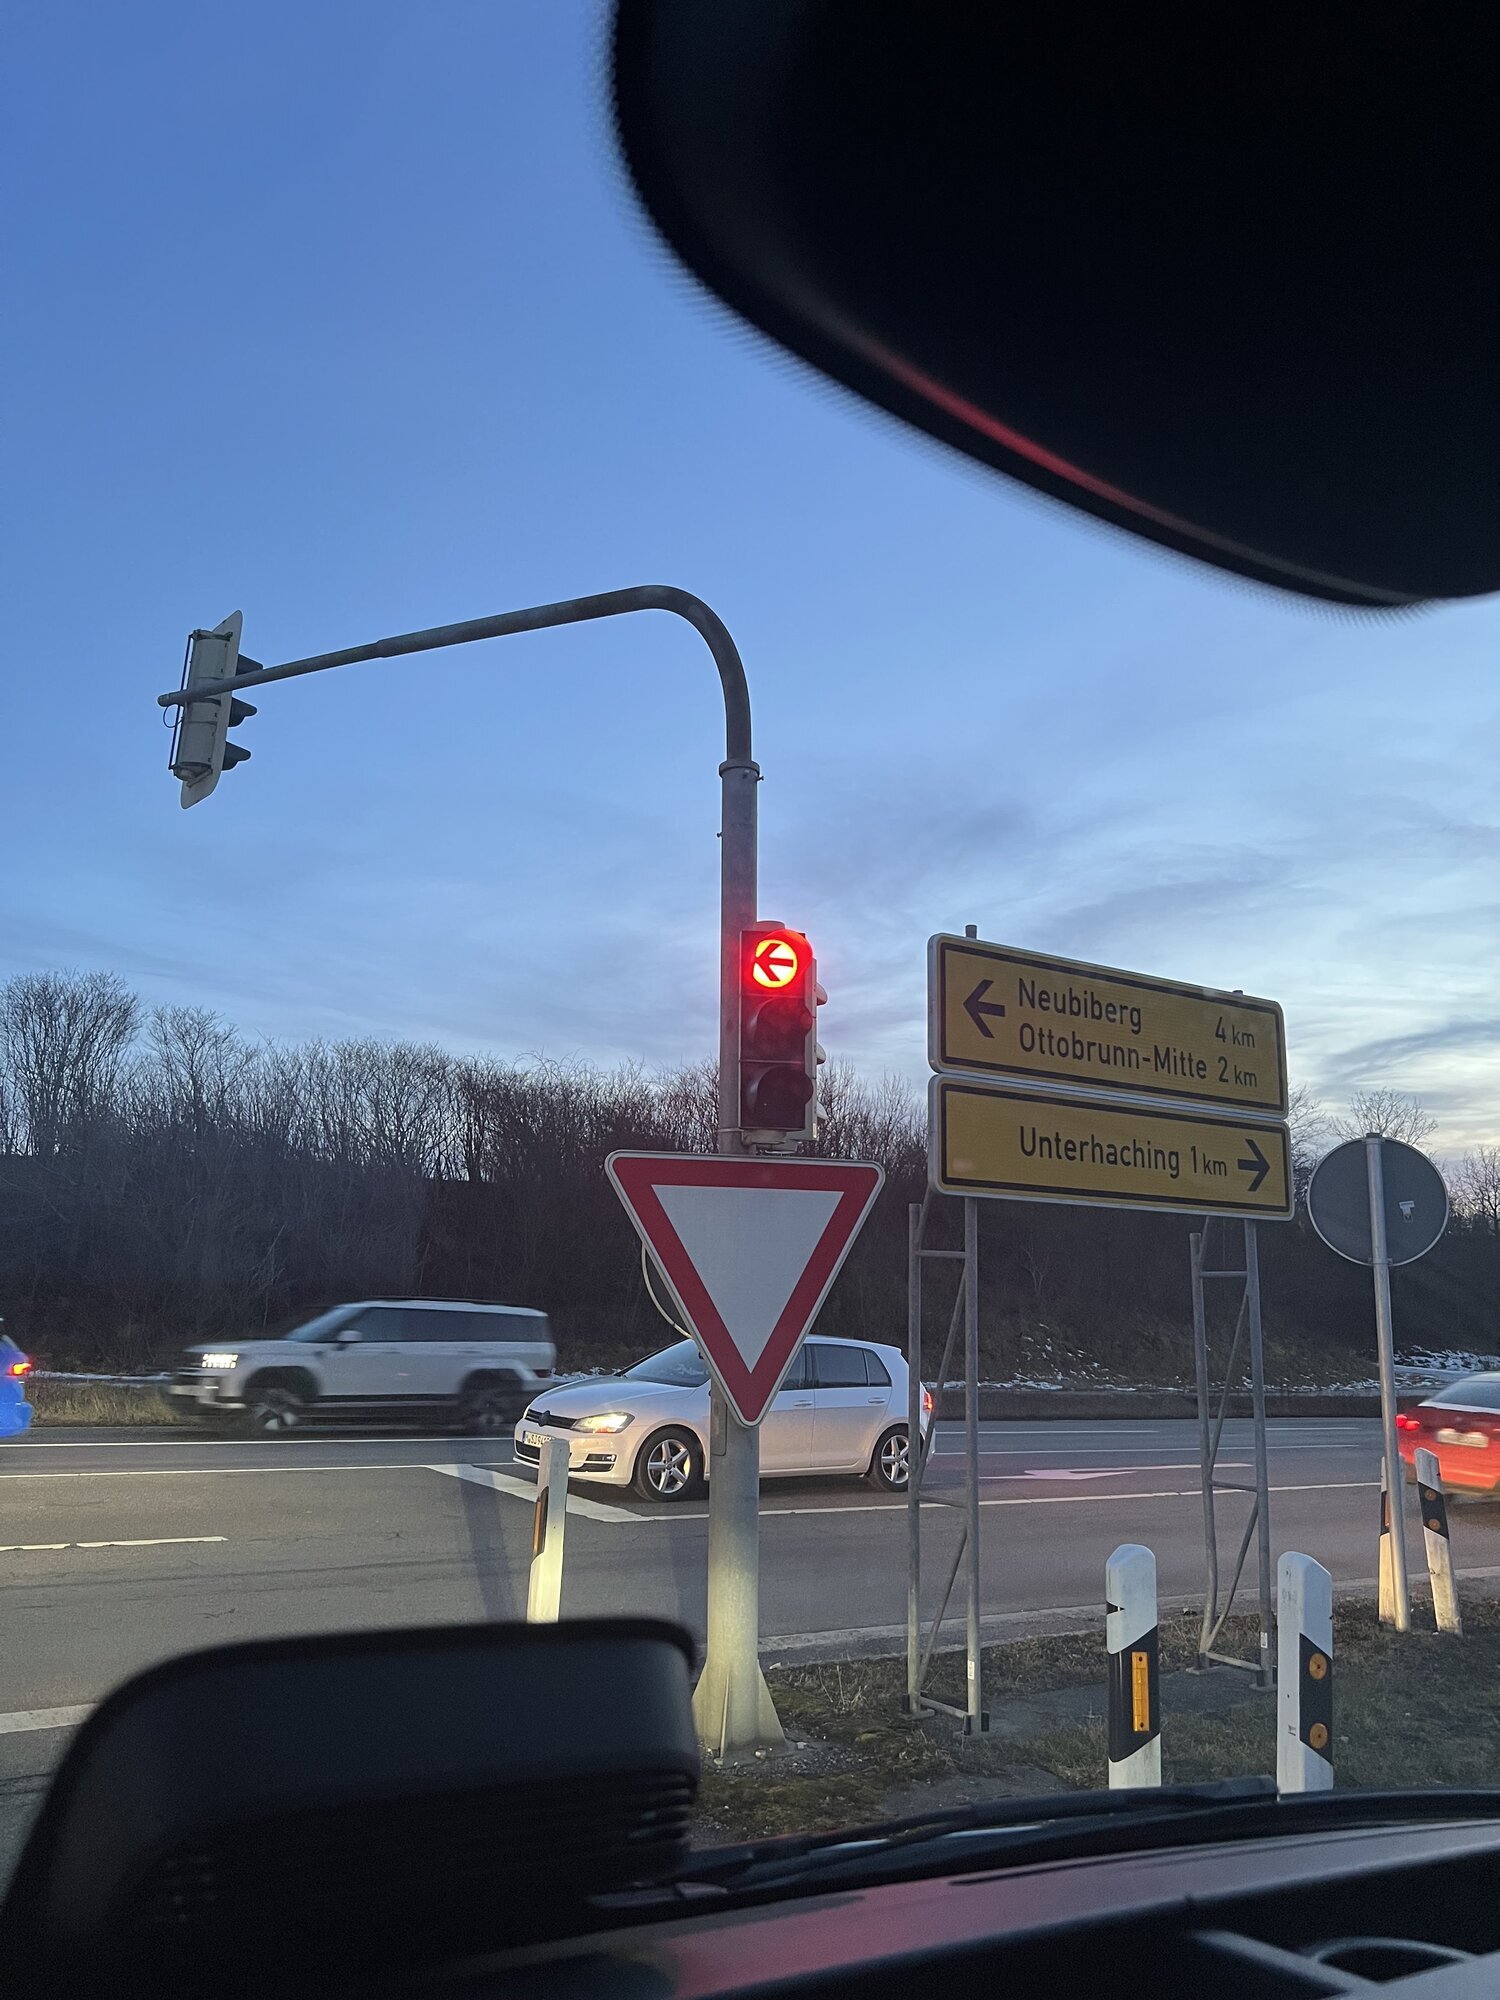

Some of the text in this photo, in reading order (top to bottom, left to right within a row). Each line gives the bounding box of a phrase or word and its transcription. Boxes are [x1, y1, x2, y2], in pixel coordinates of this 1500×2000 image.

[1018, 978, 1255, 1049] Neubiberg 4 km
[1019, 1022, 1258, 1088] Ottobrunn-Mitte 2 km
[1019, 1125, 1227, 1179] Unterhaching 1 km
